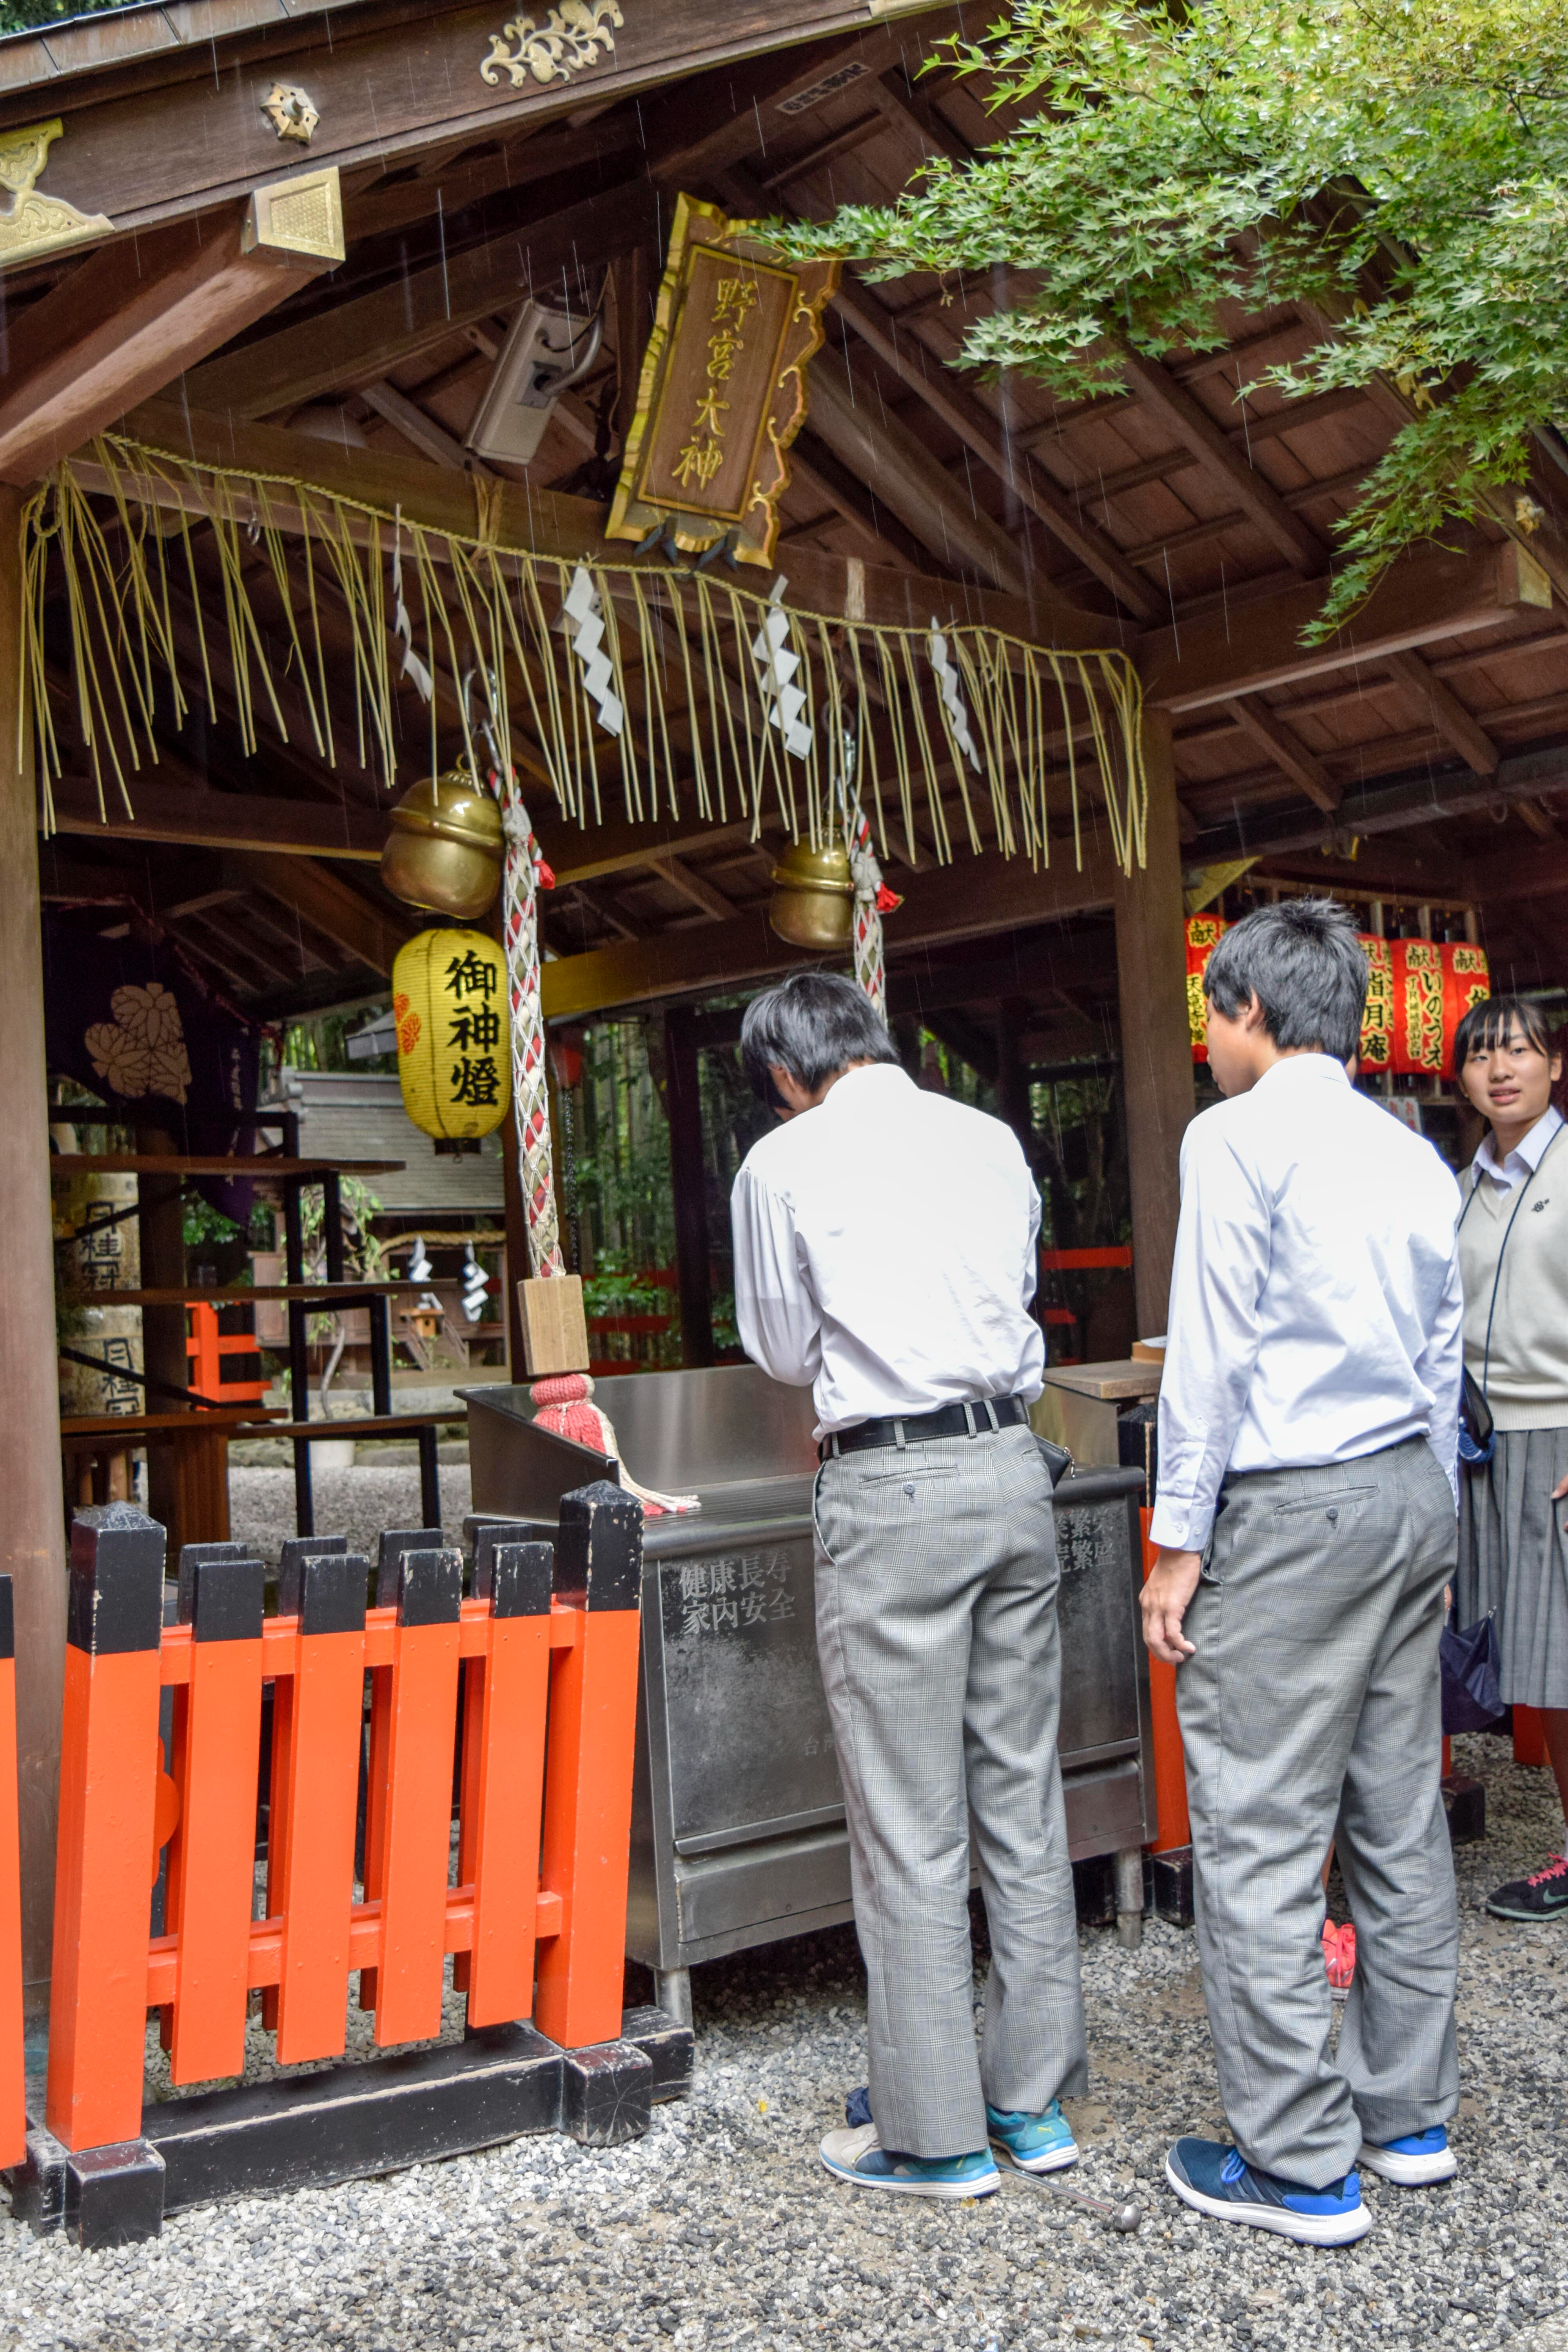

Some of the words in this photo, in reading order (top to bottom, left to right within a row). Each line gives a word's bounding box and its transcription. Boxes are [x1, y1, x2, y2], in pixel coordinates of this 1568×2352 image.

[671, 278, 757, 490] 野宮大神
[445, 949, 501, 1107] 御神燈
[1422, 971, 1443, 1067] いのうえ
[679, 1551, 792, 1600] 健康長寿
